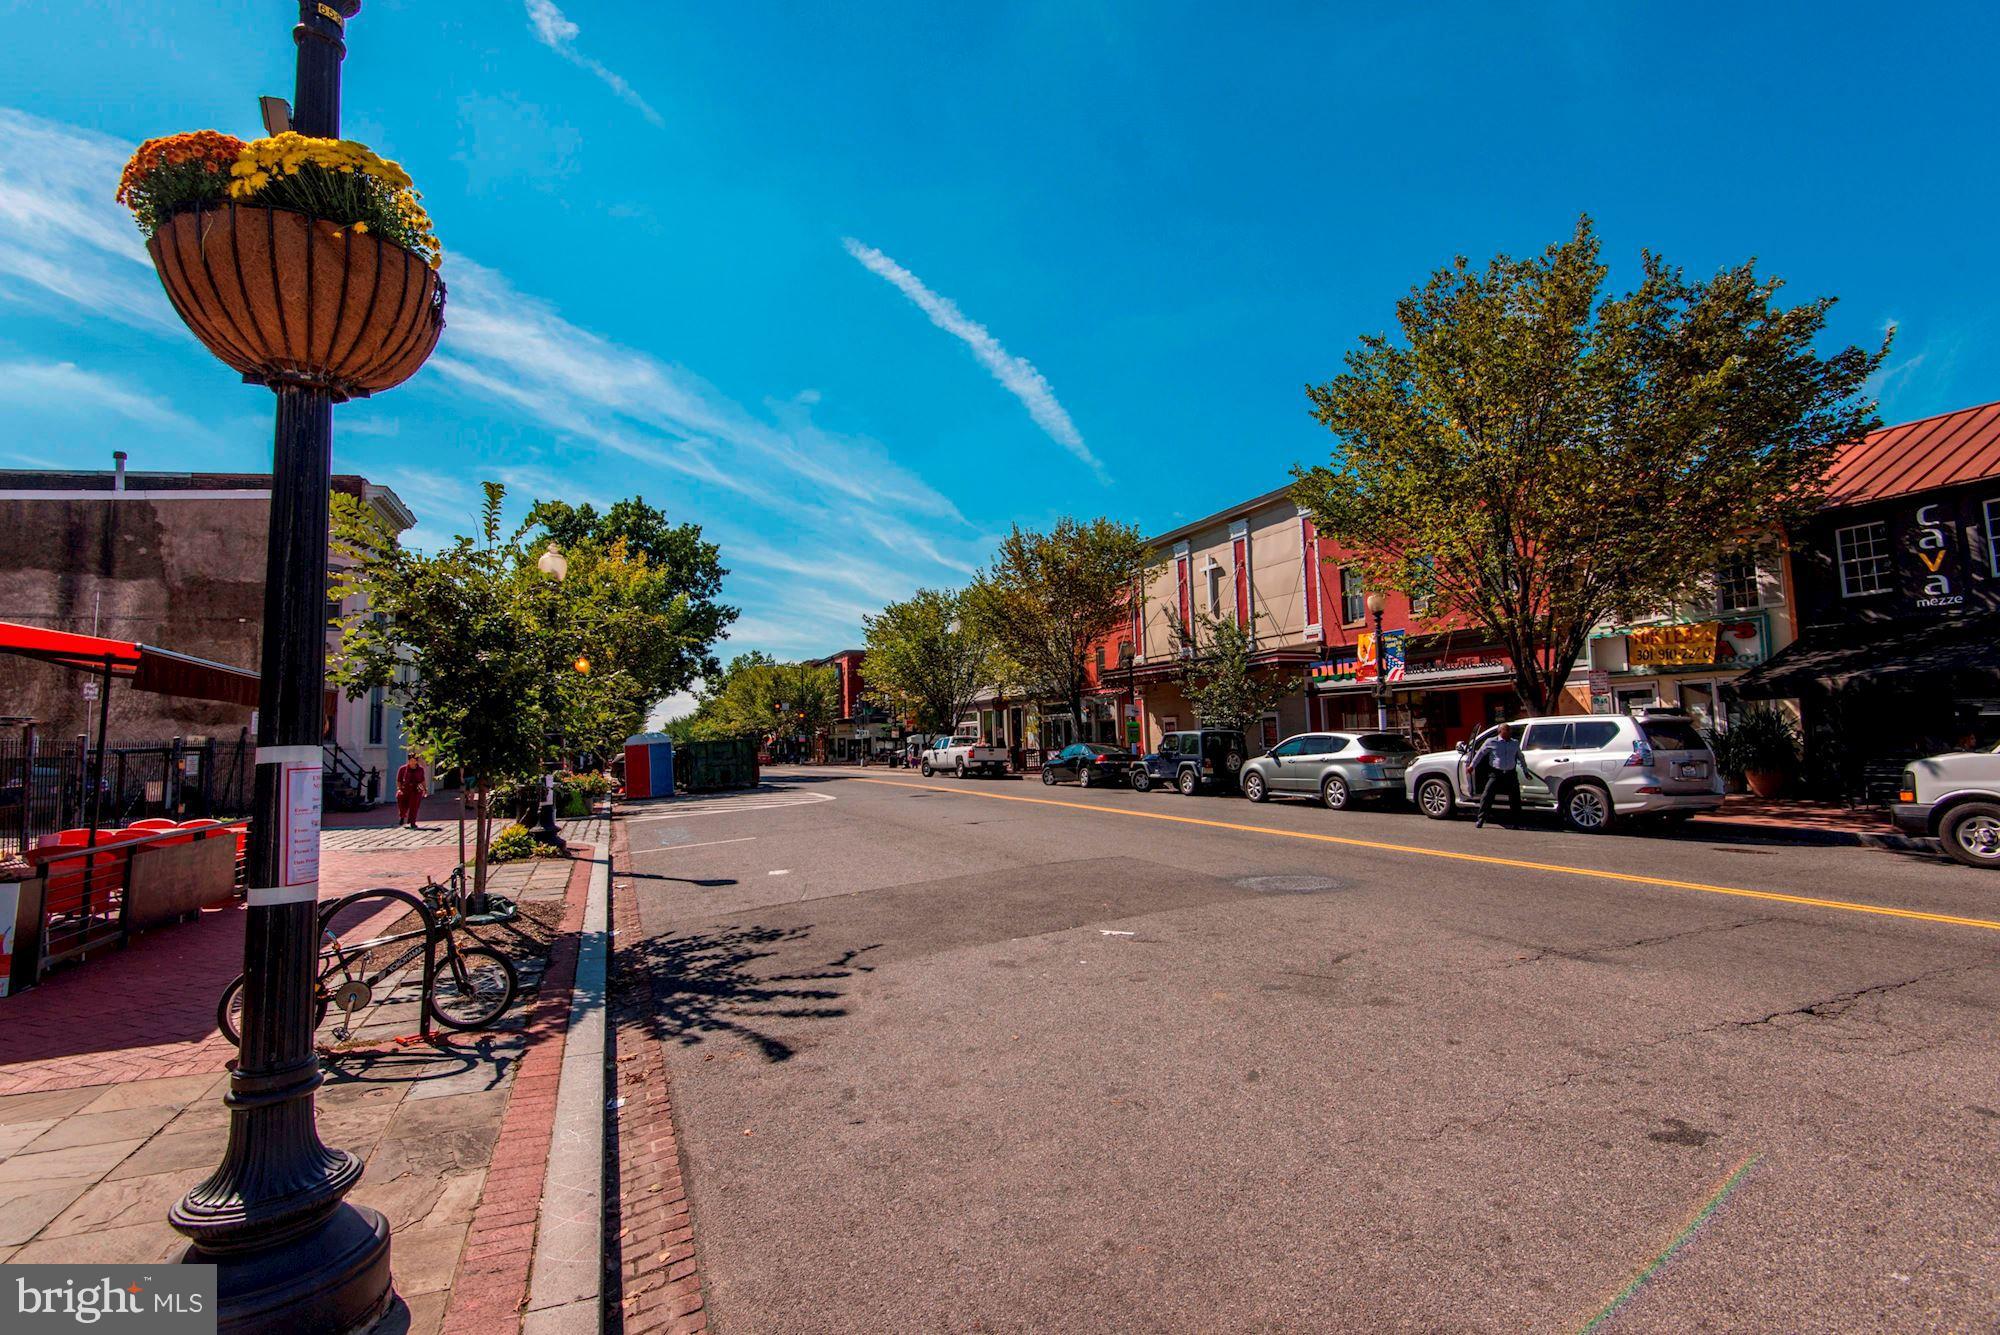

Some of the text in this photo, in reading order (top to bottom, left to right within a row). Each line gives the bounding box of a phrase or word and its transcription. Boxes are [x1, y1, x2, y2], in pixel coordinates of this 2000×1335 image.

[1916, 595, 1964, 608] mezze
[1636, 649, 1653, 661] 301
[387, 946, 425, 972] YOKOHAMA
